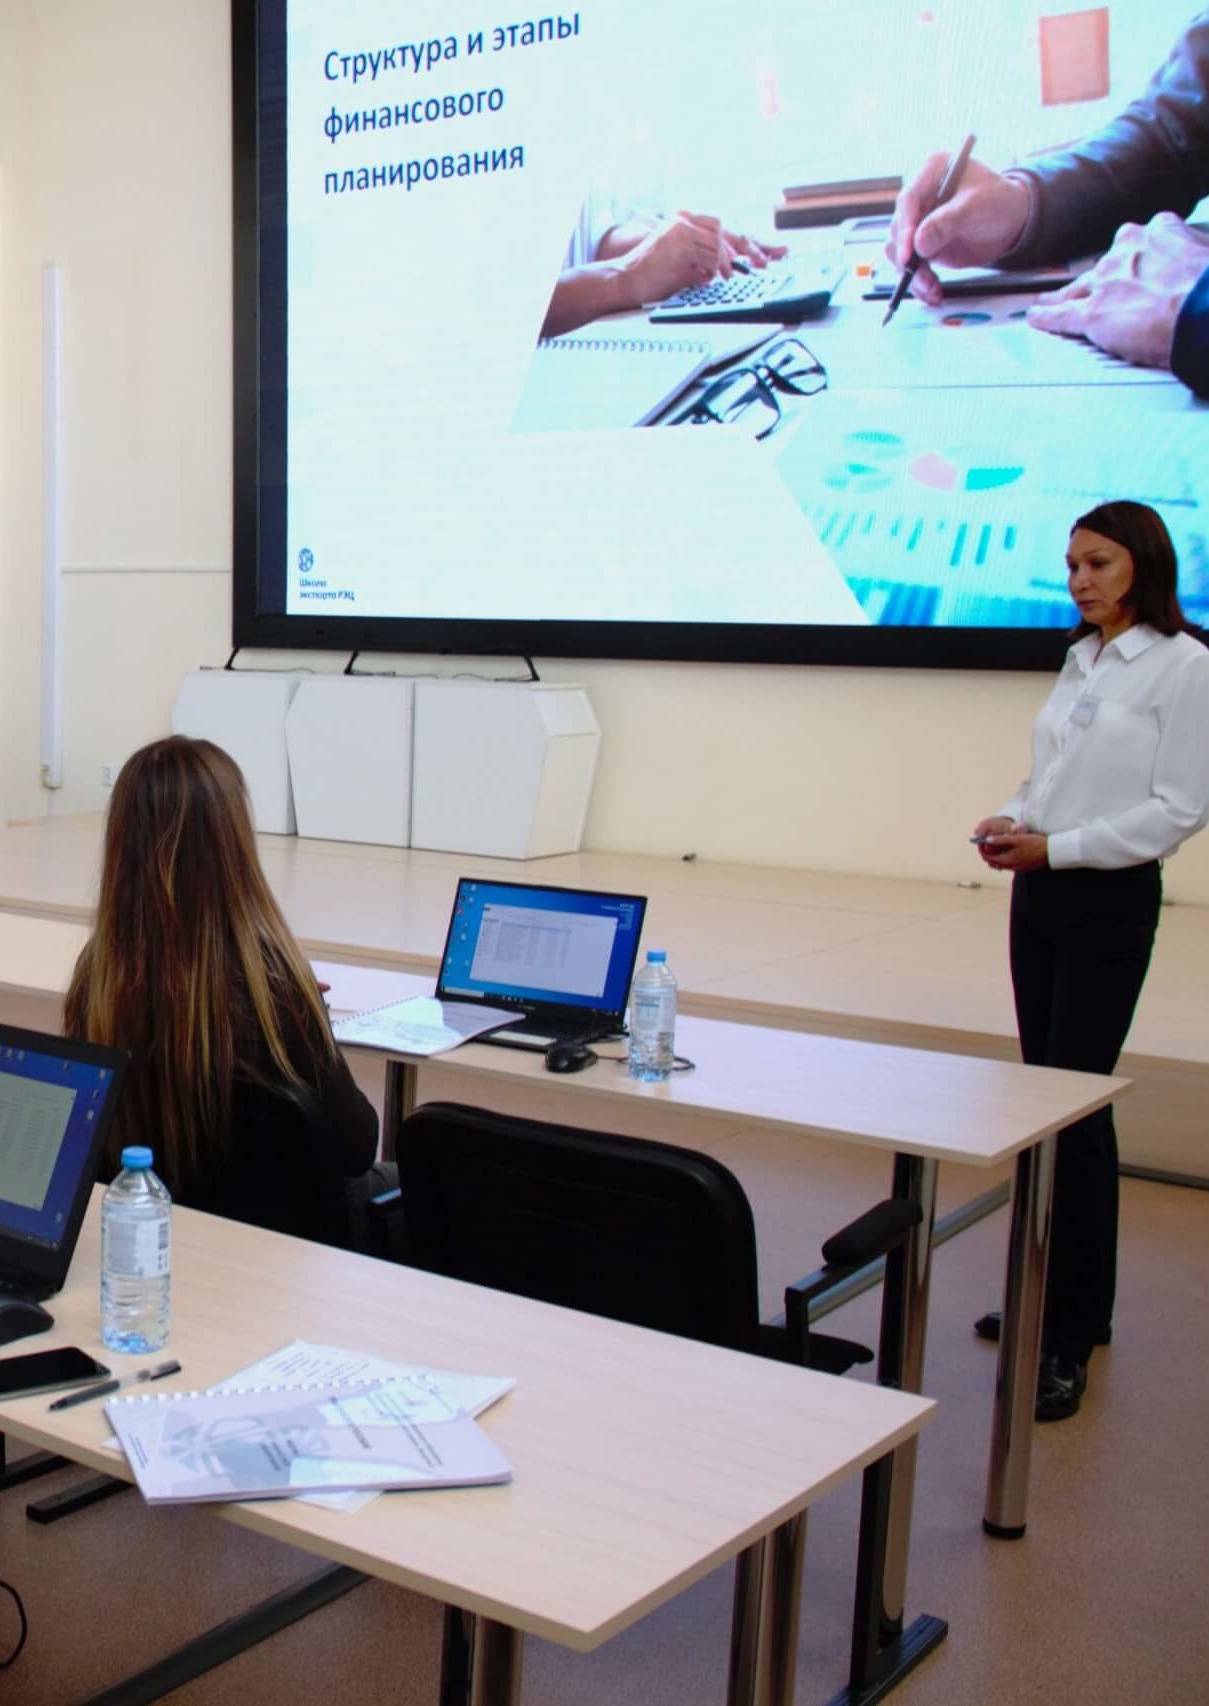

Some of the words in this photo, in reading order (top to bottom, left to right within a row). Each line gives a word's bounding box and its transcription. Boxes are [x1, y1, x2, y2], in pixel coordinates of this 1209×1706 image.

[323, 36, 458, 84] Структура
[467, 31, 483, 56] и
[492, 13, 580, 51] этапы
[323, 87, 505, 144] финансового
[323, 145, 525, 194] планирования
